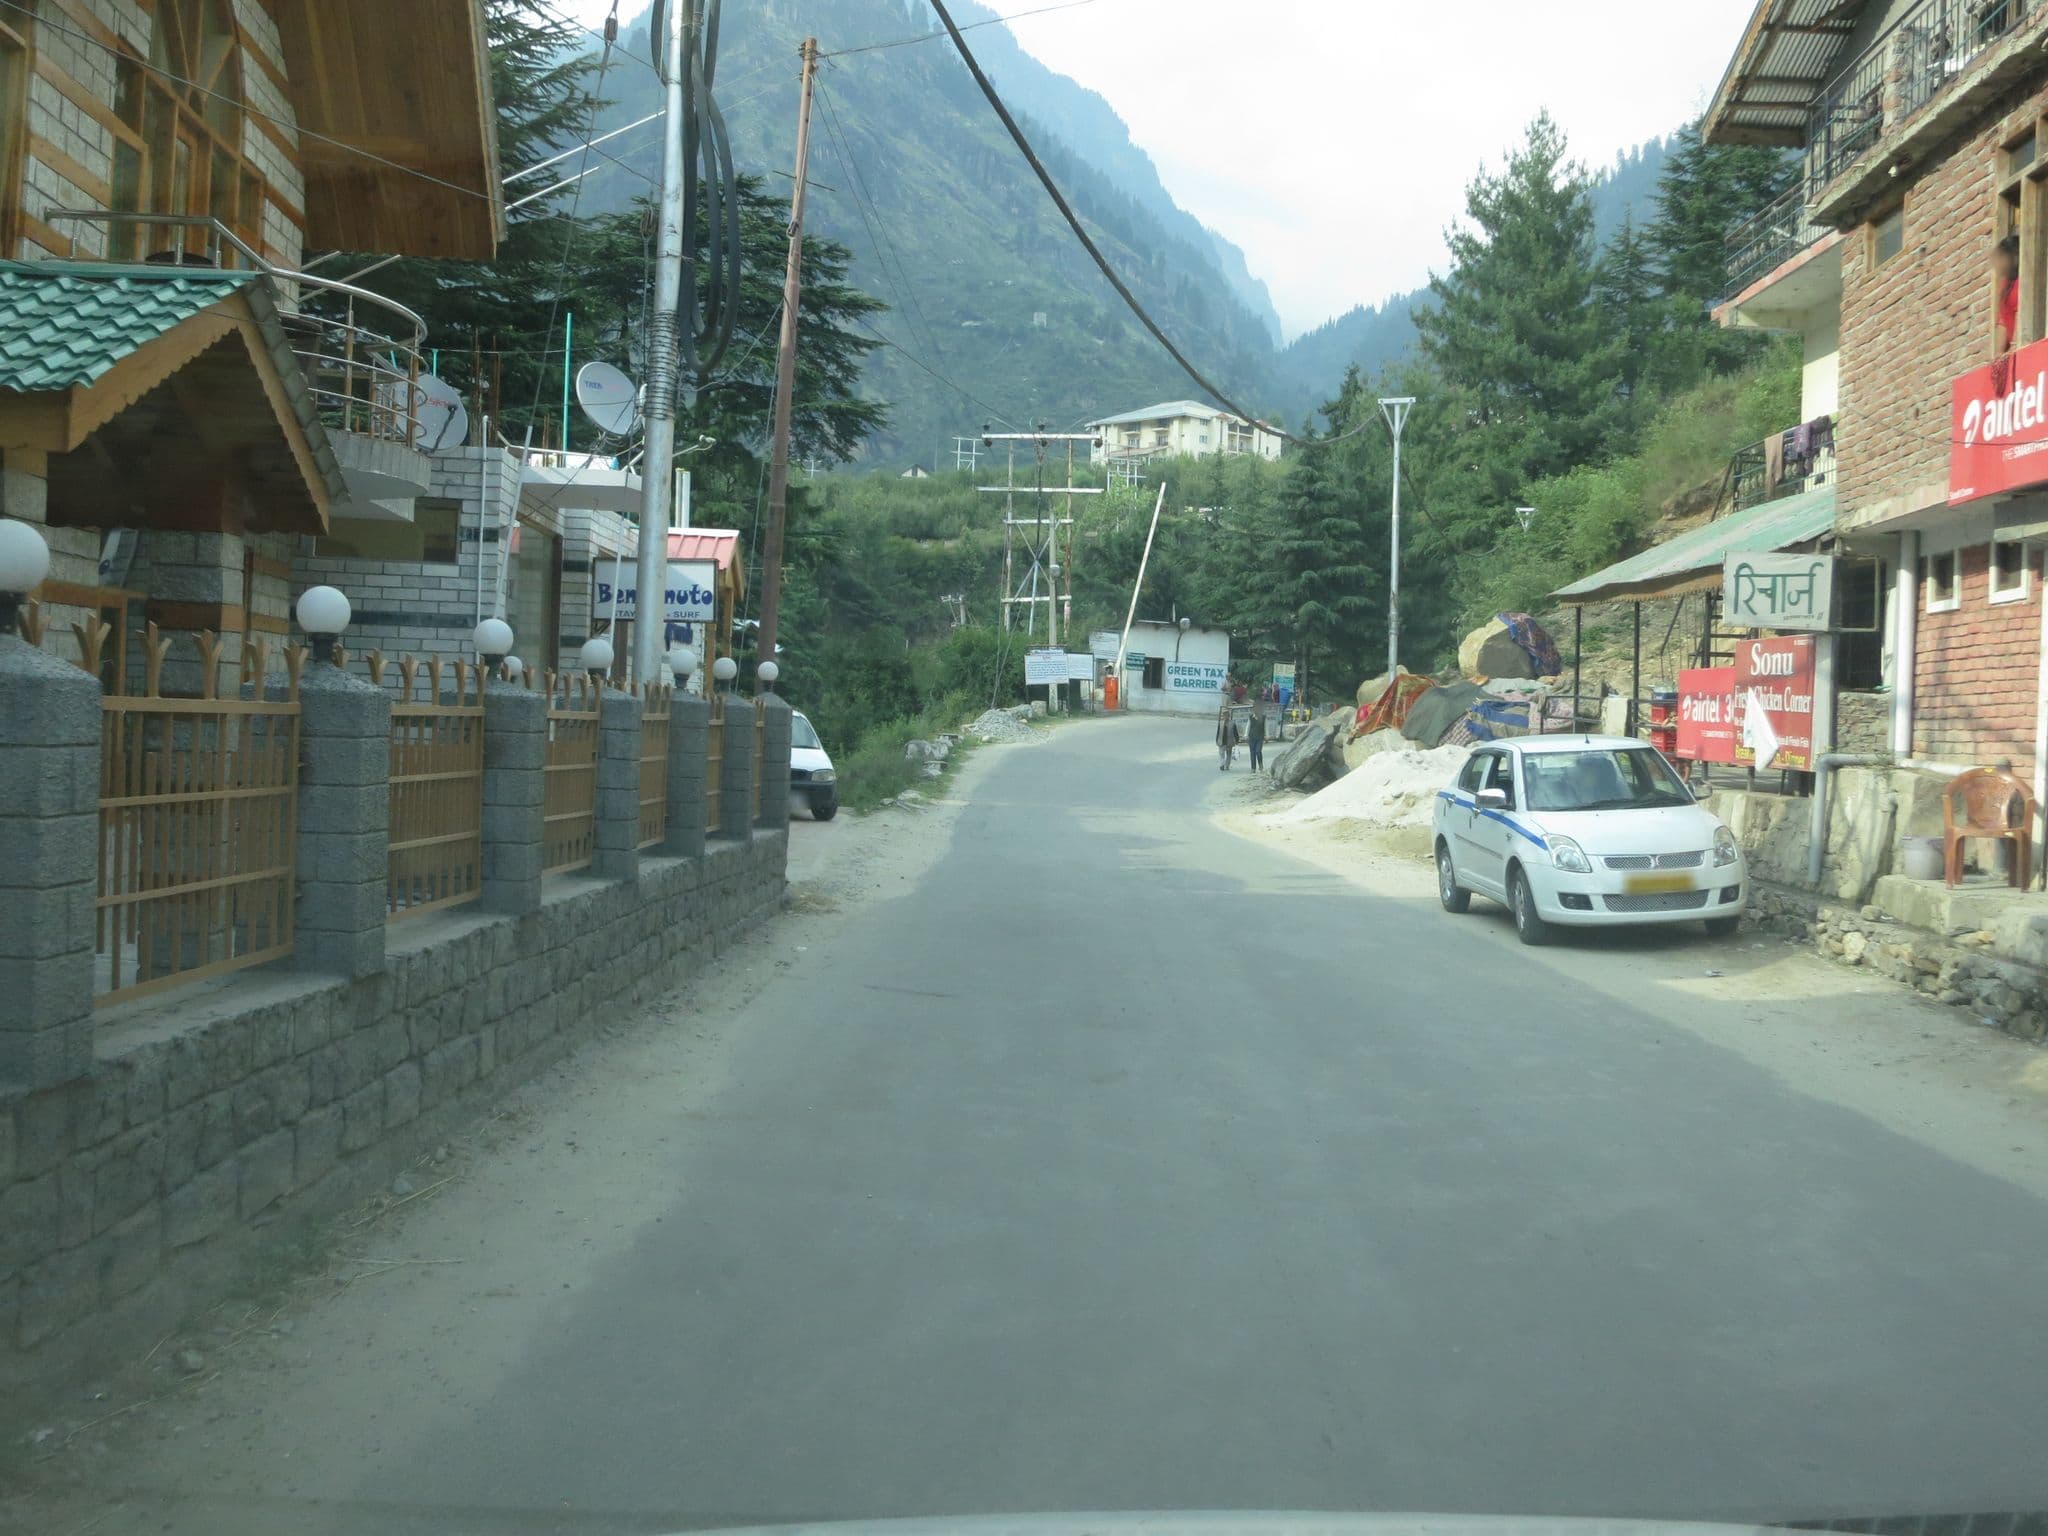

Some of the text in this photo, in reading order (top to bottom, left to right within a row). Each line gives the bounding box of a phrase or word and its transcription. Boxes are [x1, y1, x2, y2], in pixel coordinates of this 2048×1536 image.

[1983, 371, 2046, 441] airtel
[597, 583, 713, 605] Bennuto
[1733, 562, 1824, 615] रिचार्ज
[673, 610, 700, 618] SURF
[1167, 665, 1225, 678] GREEN TAX
[1750, 643, 1793, 676] Sonu
[1174, 678, 1218, 689] BARRIER
[1692, 691, 1719, 723] airtel
[1783, 686, 1811, 713] Corner
